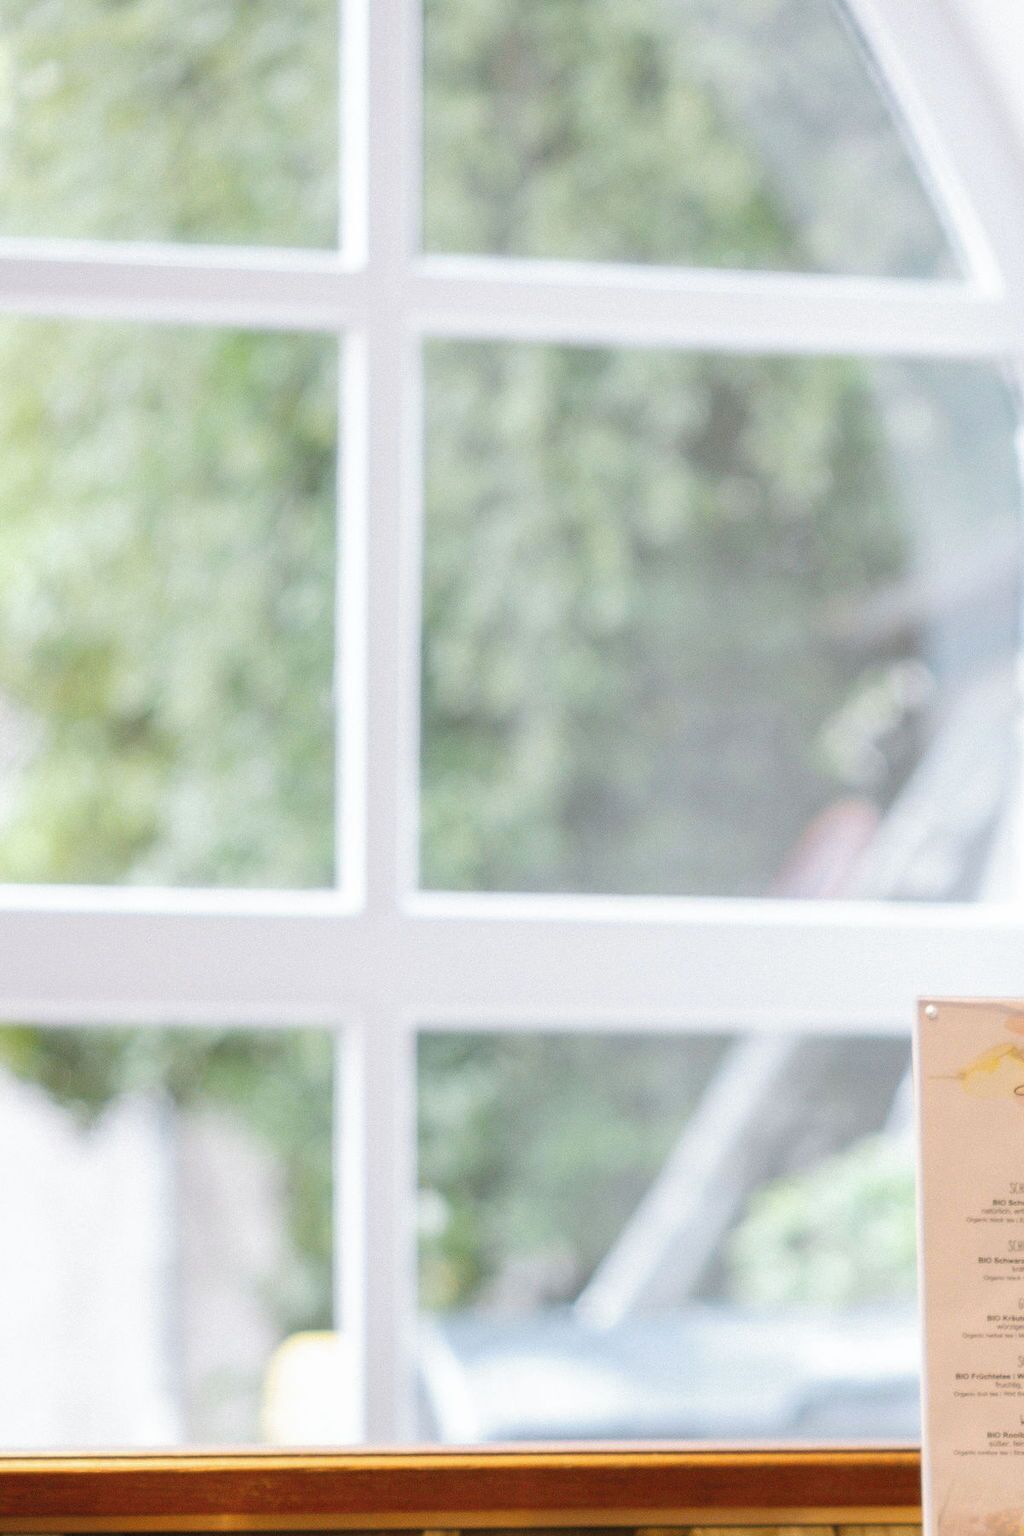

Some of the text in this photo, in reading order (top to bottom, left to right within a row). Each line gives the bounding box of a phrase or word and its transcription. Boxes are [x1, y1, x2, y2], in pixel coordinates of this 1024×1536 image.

[992, 1199, 1007, 1207] BIO
[977, 1256, 992, 1265] BIO
[986, 1314, 1001, 1323] BIO
[955, 1373, 970, 1382] BIO
[986, 1431, 1001, 1439] BIO
